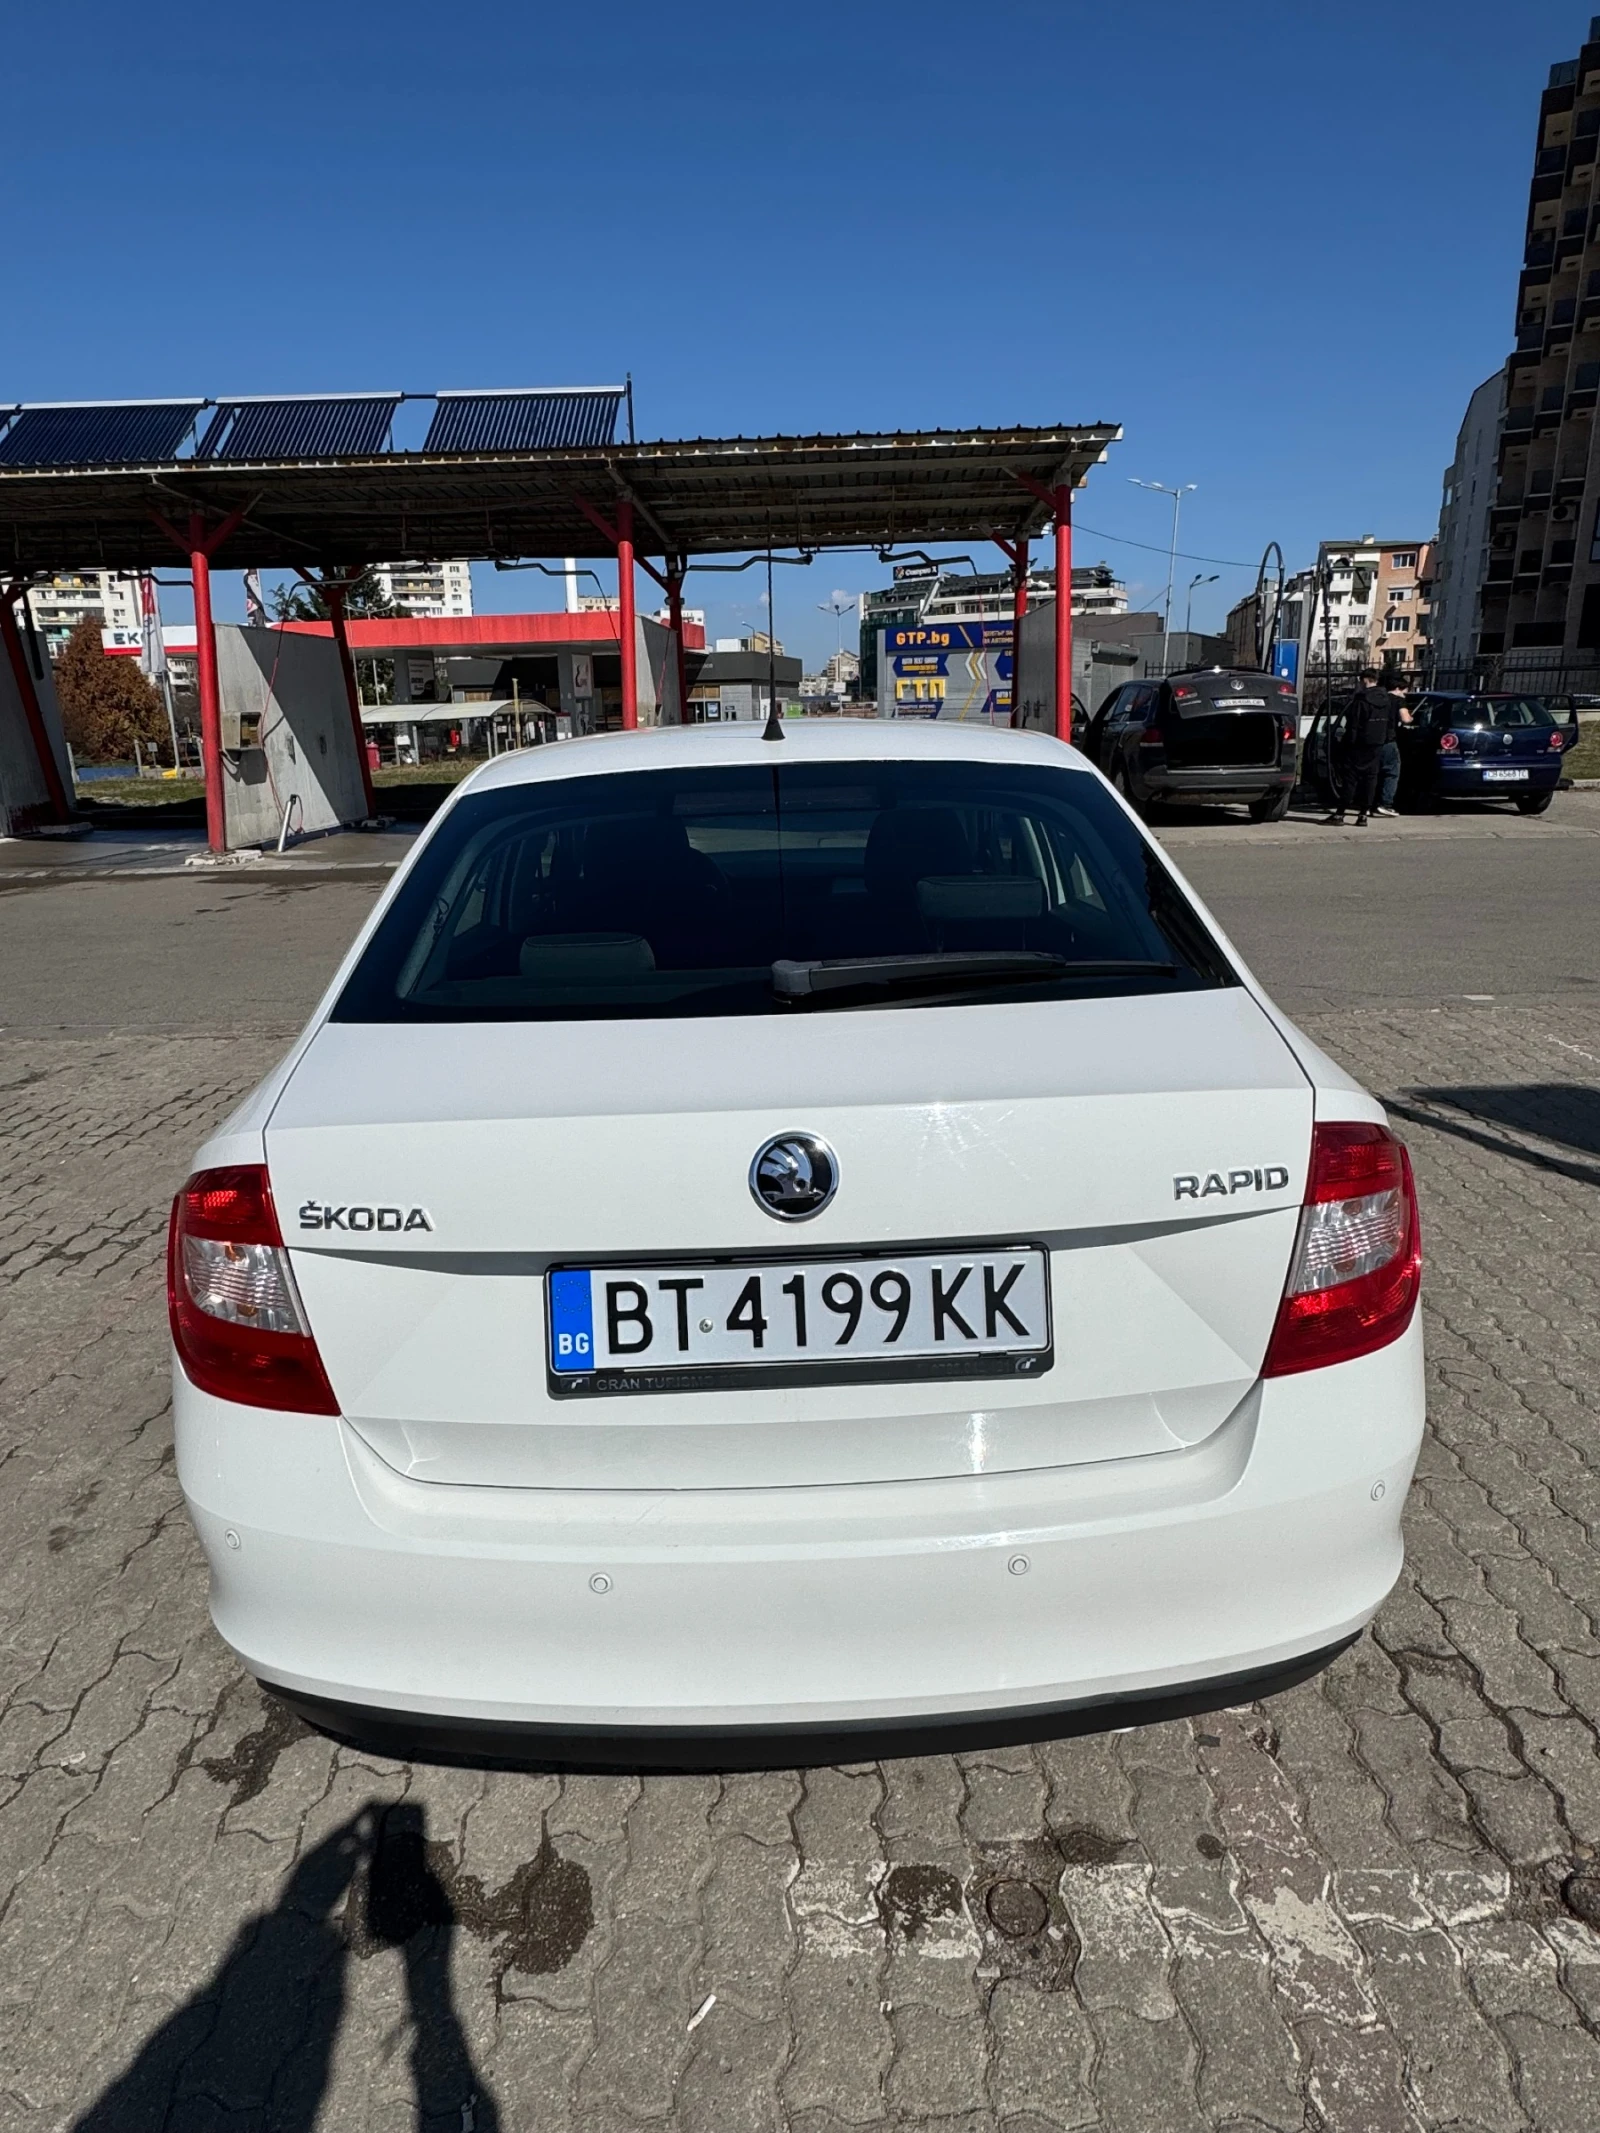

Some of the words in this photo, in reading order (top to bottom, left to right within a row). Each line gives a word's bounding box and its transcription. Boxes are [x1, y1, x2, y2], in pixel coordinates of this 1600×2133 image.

[113, 632, 143, 645] EK
[896, 631, 950, 646] GTP.bg
[896, 678, 946, 699] ГТП
[1172, 1166, 1289, 1201] RAPID
[299, 1200, 433, 1231] ŠKODA
[605, 1278, 704, 1355] BT
[726, 1270, 911, 1349] 4199
[931, 1263, 1030, 1342] KK
[558, 1333, 590, 1355] BG
